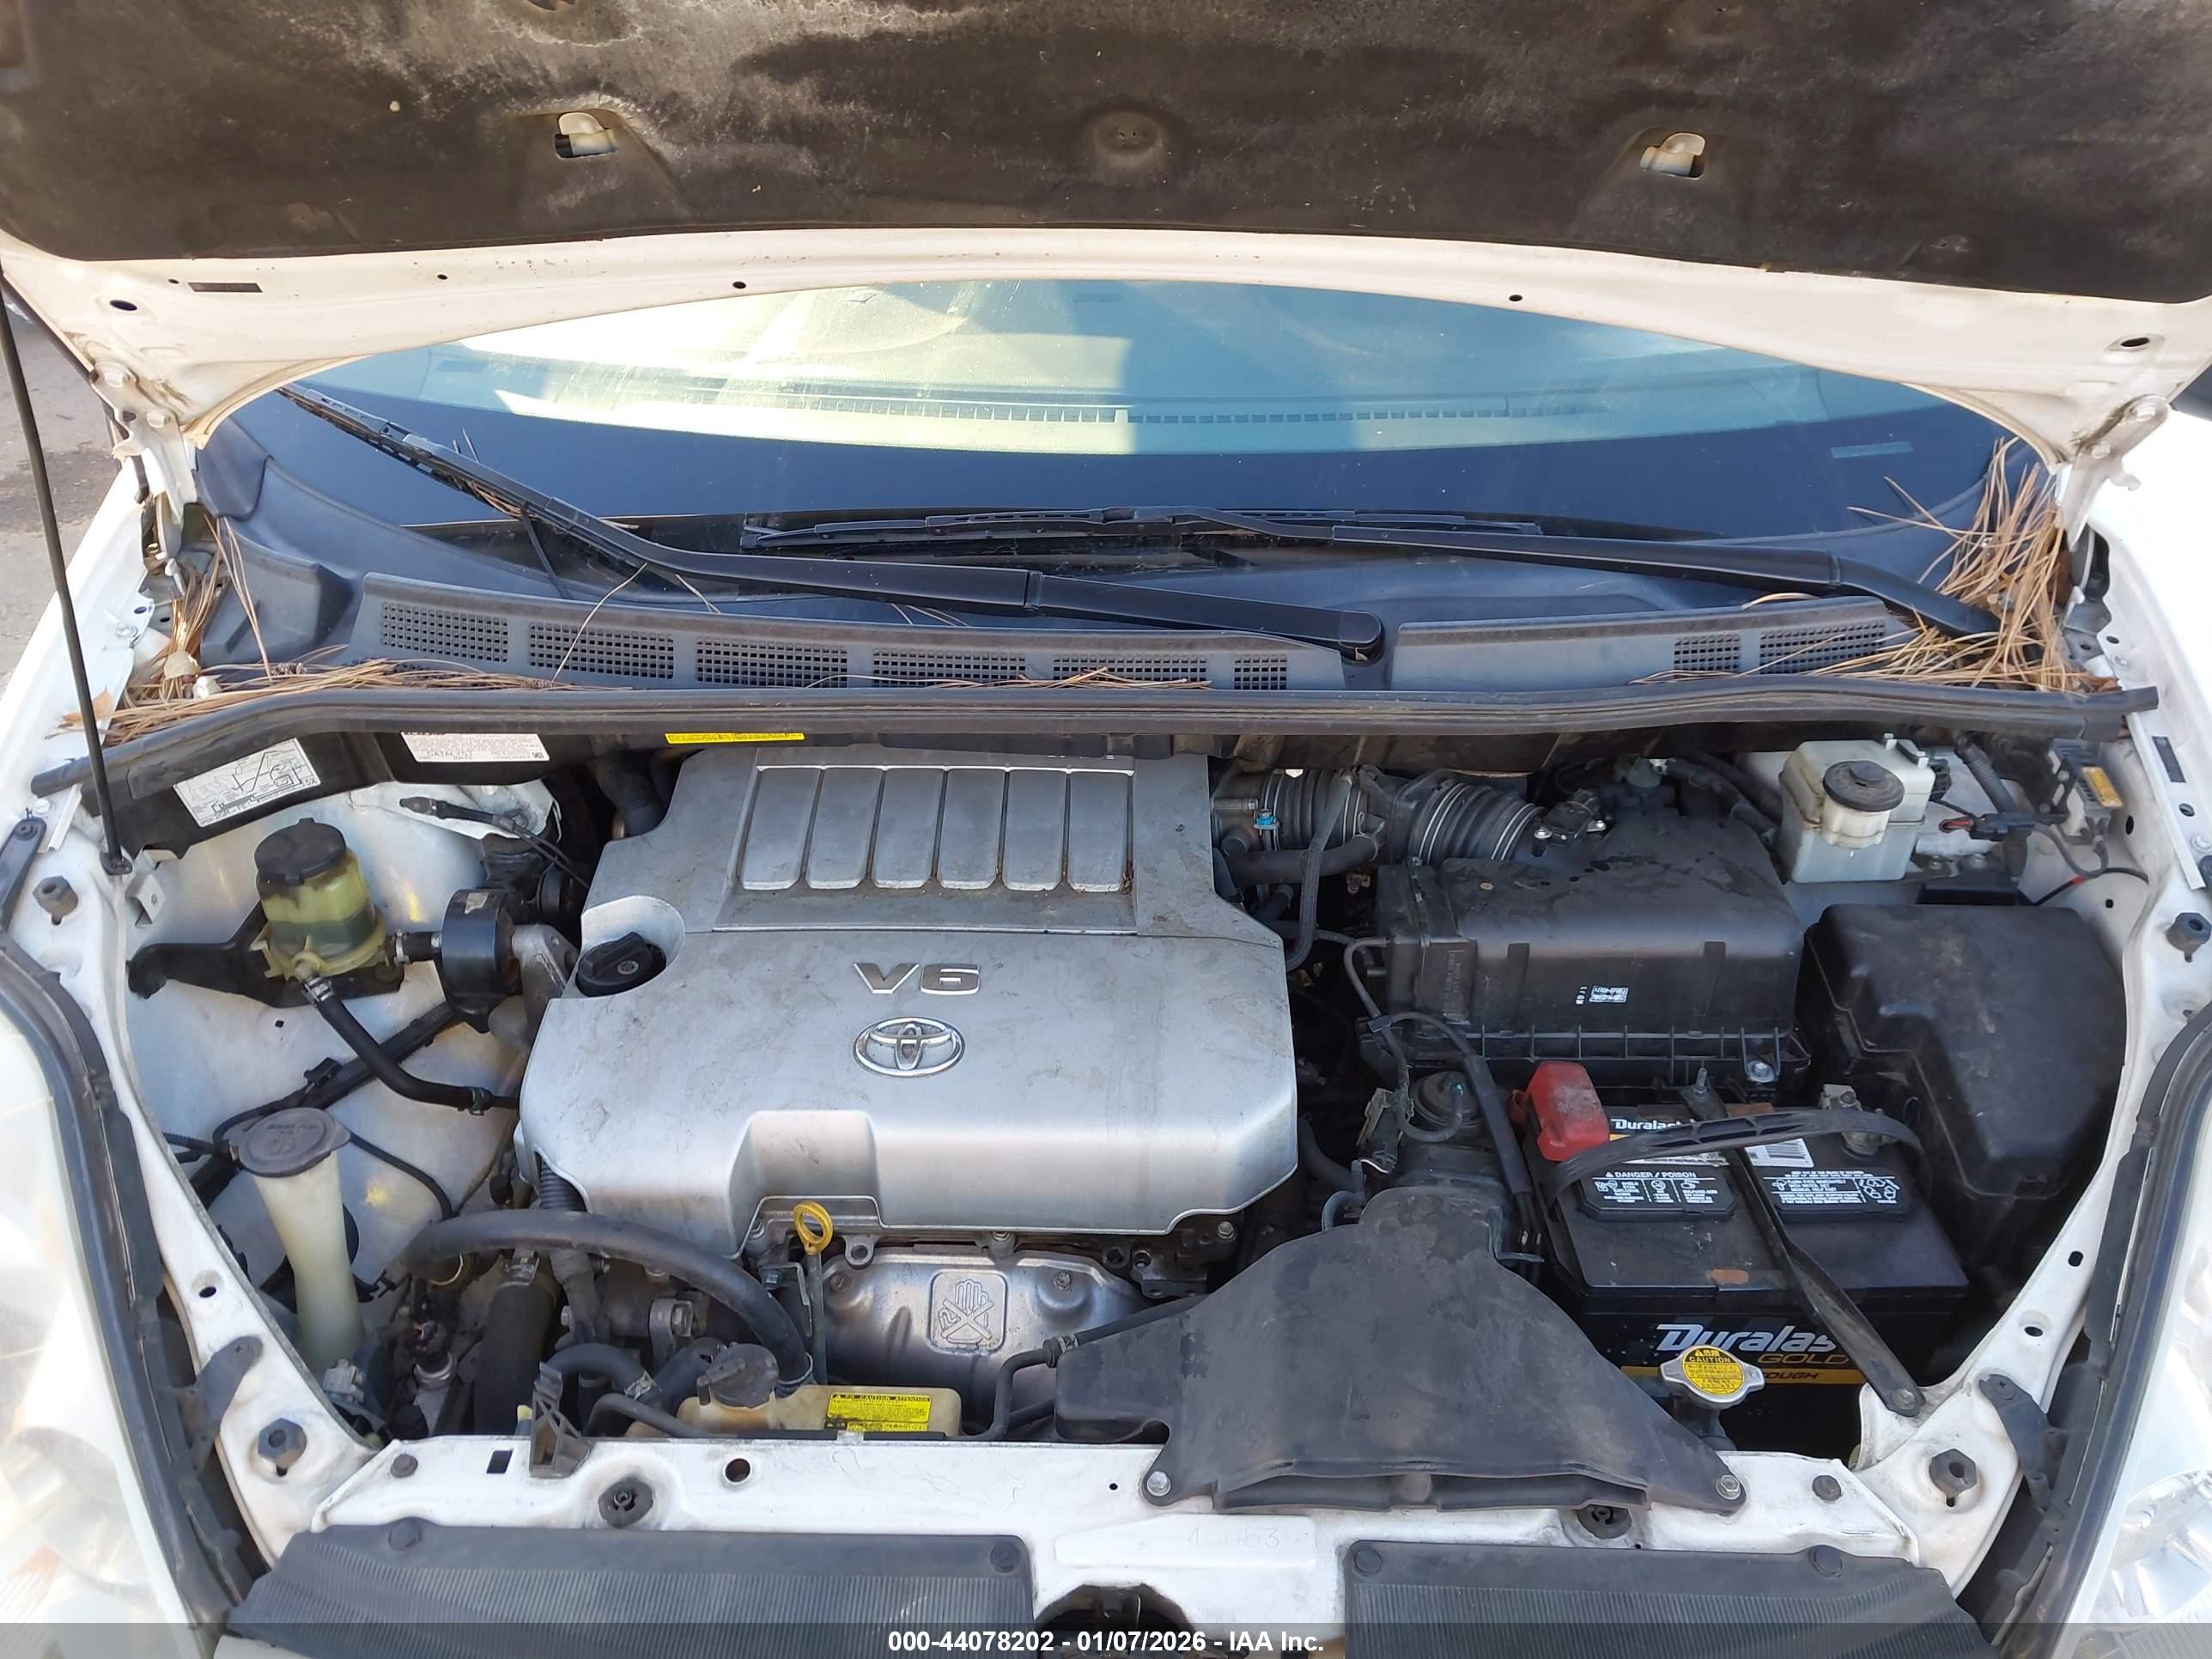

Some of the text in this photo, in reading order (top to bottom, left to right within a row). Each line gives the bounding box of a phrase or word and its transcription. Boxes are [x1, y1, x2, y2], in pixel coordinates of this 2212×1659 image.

[853, 962, 981, 995] V6
[1610, 1118, 1681, 1130] Durala
[1656, 1323, 1837, 1352] Duralas
[1758, 1353, 1850, 1364] GOLD
[1765, 1371, 1820, 1380] OUGH
